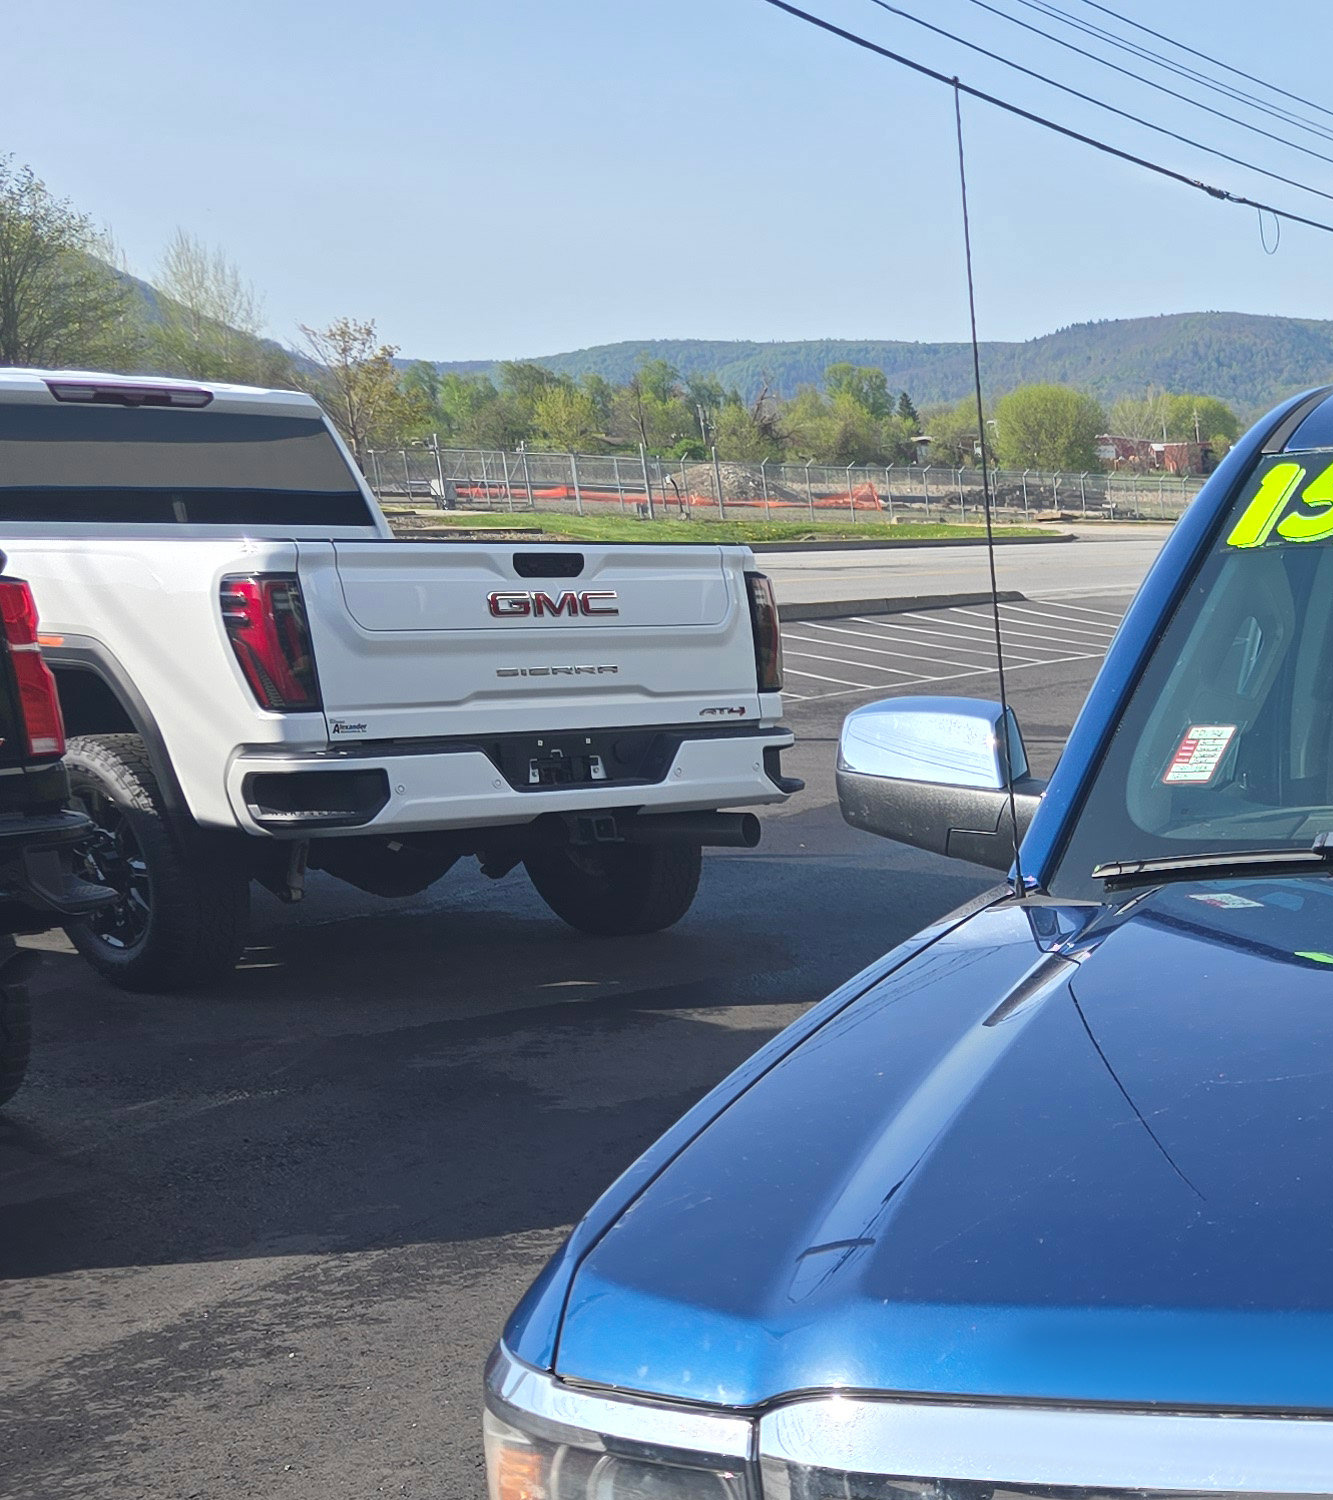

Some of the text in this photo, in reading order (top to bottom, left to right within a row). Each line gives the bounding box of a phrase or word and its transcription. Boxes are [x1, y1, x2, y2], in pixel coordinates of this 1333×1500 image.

[487, 590, 619, 618] GMC
[496, 664, 619, 678] SIERRA
[699, 706, 746, 717] AT4
